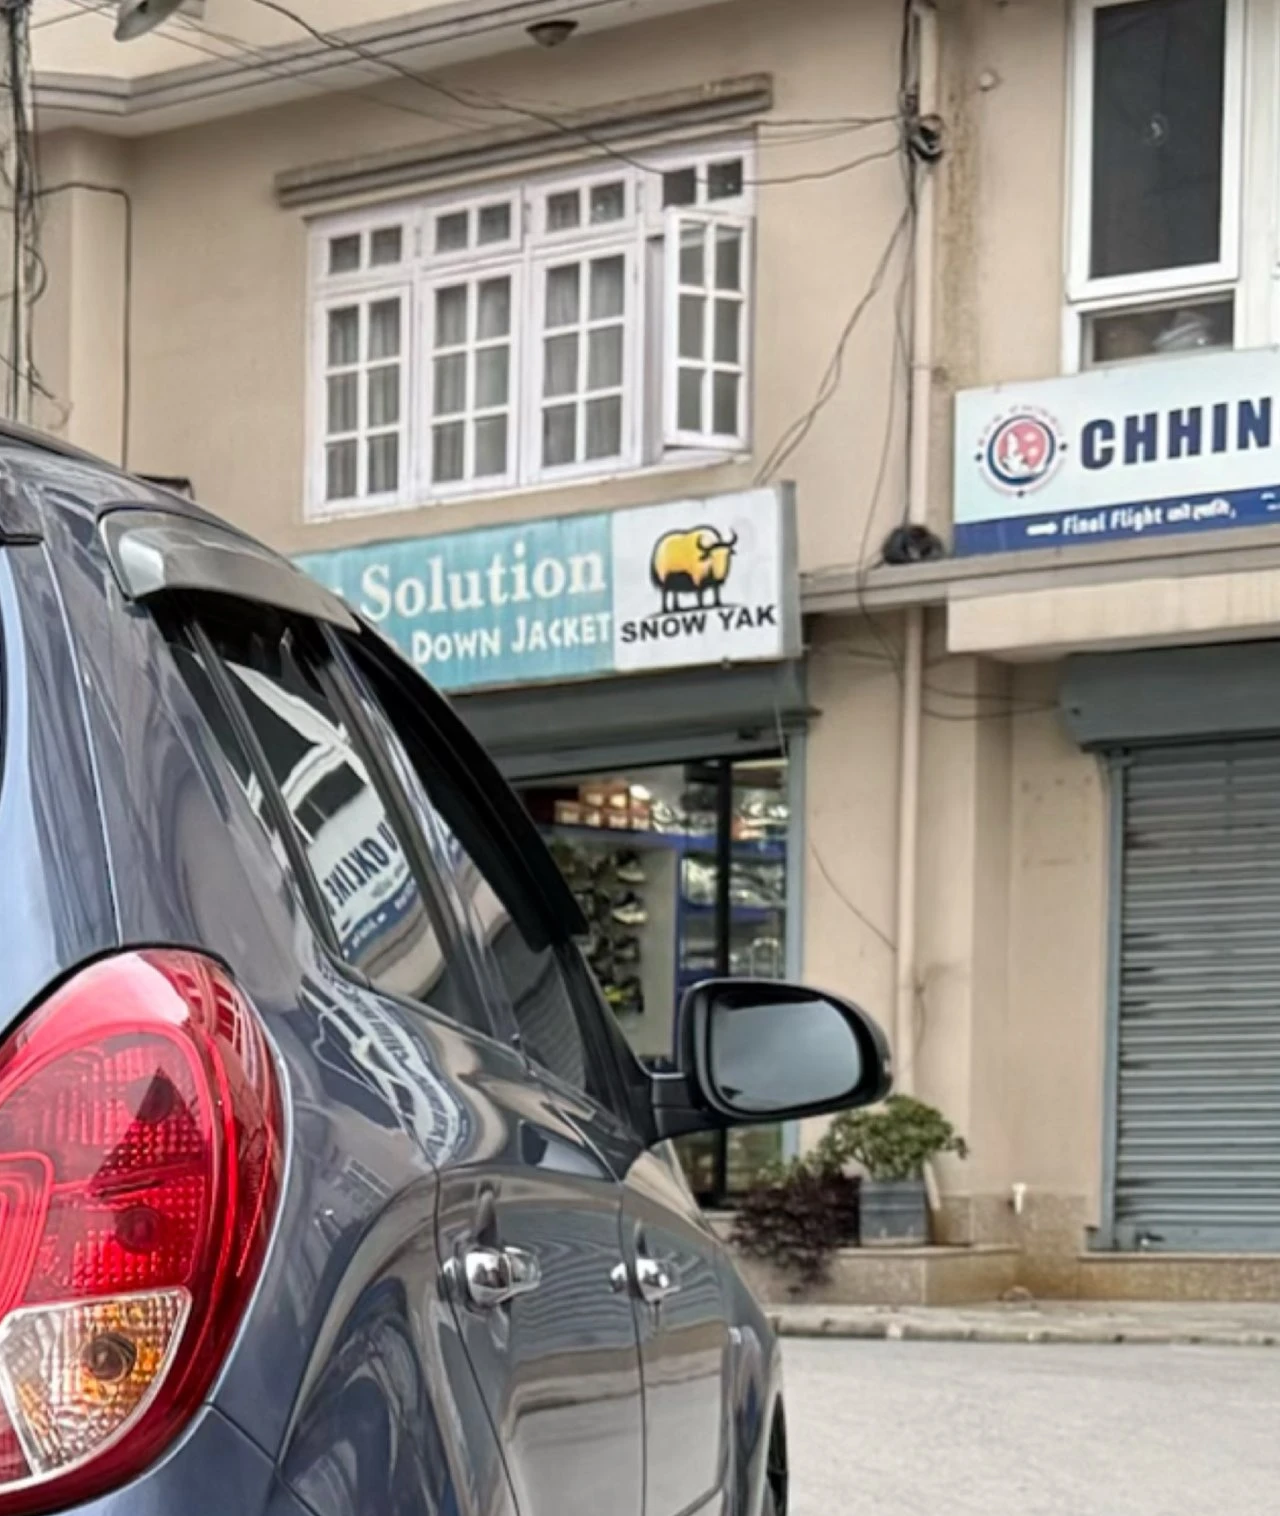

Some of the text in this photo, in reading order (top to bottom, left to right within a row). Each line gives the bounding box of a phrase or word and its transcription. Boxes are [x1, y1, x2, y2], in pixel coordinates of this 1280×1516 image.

[1061, 512, 1106, 536] Final
[1110, 504, 1163, 531] Flight
[360, 541, 607, 622] Solution
[620, 603, 778, 643] SNOW YAK
